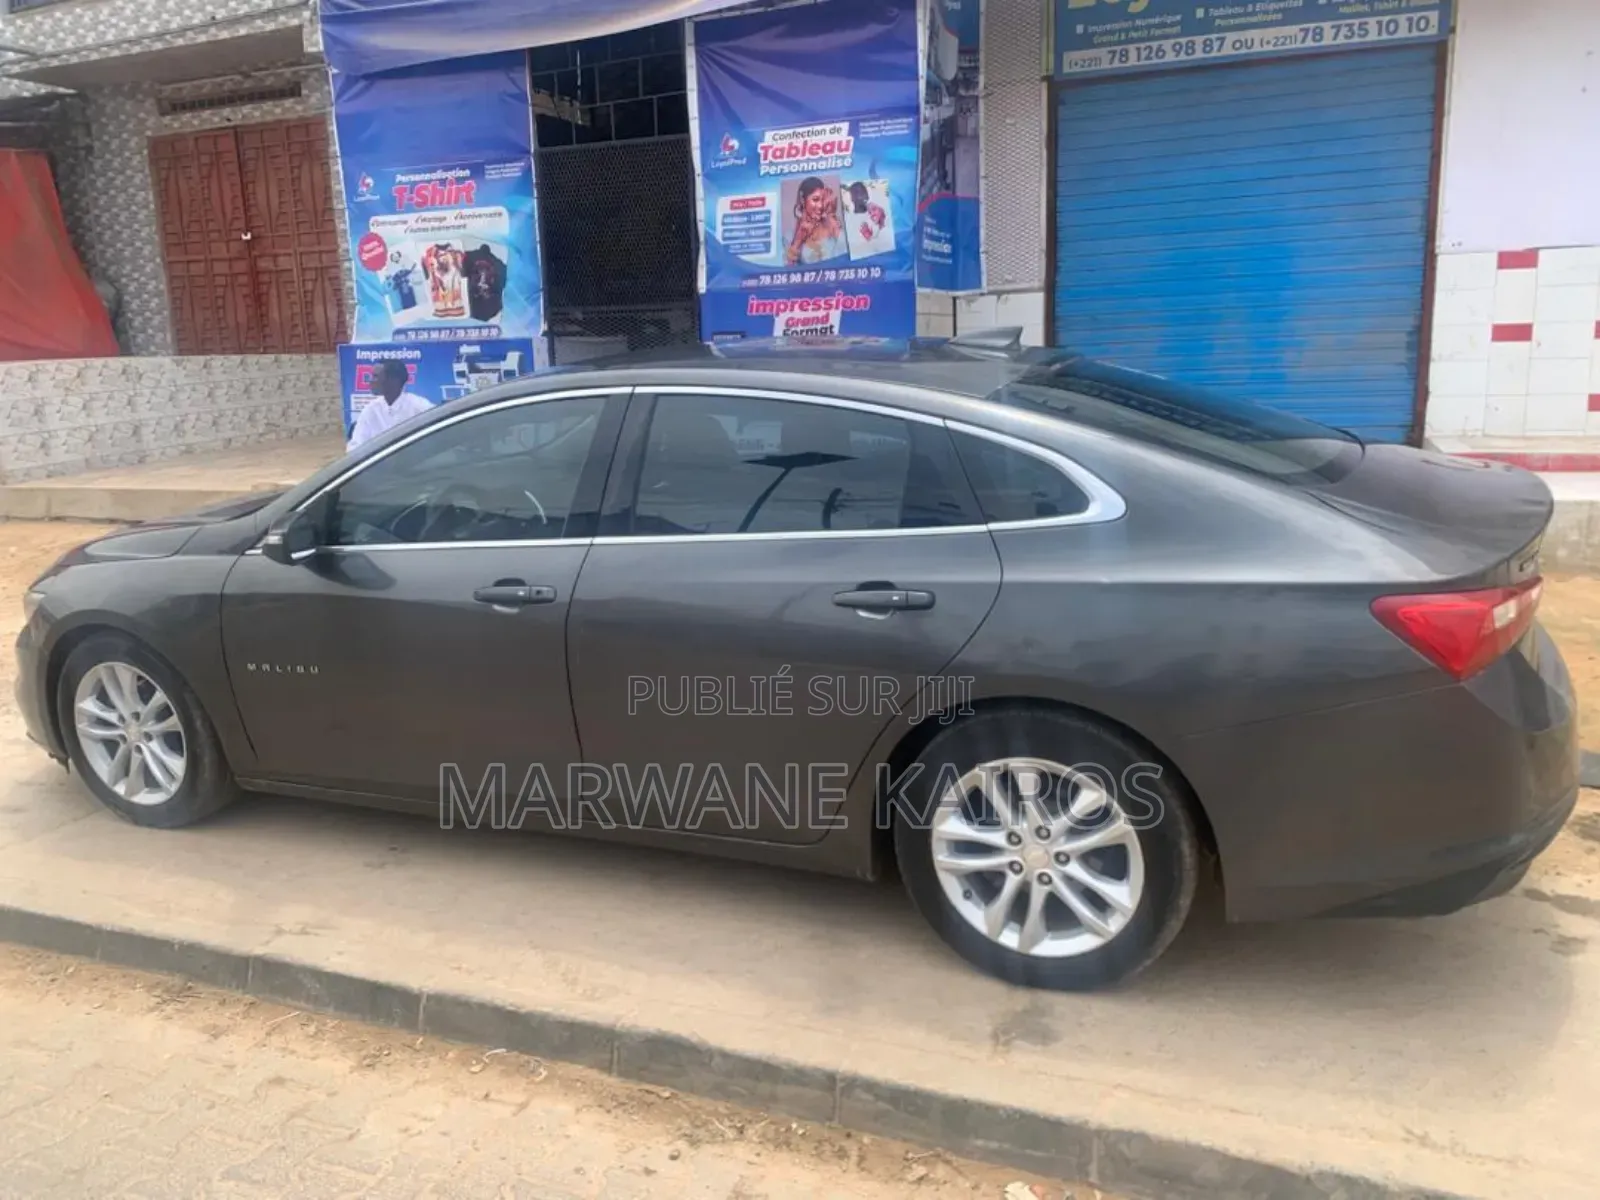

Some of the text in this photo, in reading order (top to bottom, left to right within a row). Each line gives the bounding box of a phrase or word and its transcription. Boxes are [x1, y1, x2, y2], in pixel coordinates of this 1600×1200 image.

[1107, 48, 1129, 65] 78
[1135, 45, 1167, 63] 126
[1171, 40, 1196, 58] 98
[1202, 36, 1227, 54] 87
[1299, 25, 1323, 44] 78
[1330, 21, 1370, 42] 735
[1376, 17, 1399, 37] 10
[1406, 15, 1430, 34] 10
[772, 126, 843, 142] Confection de
[759, 138, 852, 161] Tableau
[392, 176, 476, 210] T-Shirt
[760, 274, 771, 285] 78
[773, 273, 787, 284] 126
[804, 272, 816, 283] 87
[824, 270, 836, 281] 78
[857, 267, 868, 278] 10
[870, 267, 881, 278] 10
[748, 291, 870, 317] impression
[785, 312, 831, 328] Grand
[782, 324, 835, 337] Format
[356, 347, 422, 363] Impression
[246, 663, 319, 674] MALIBU
